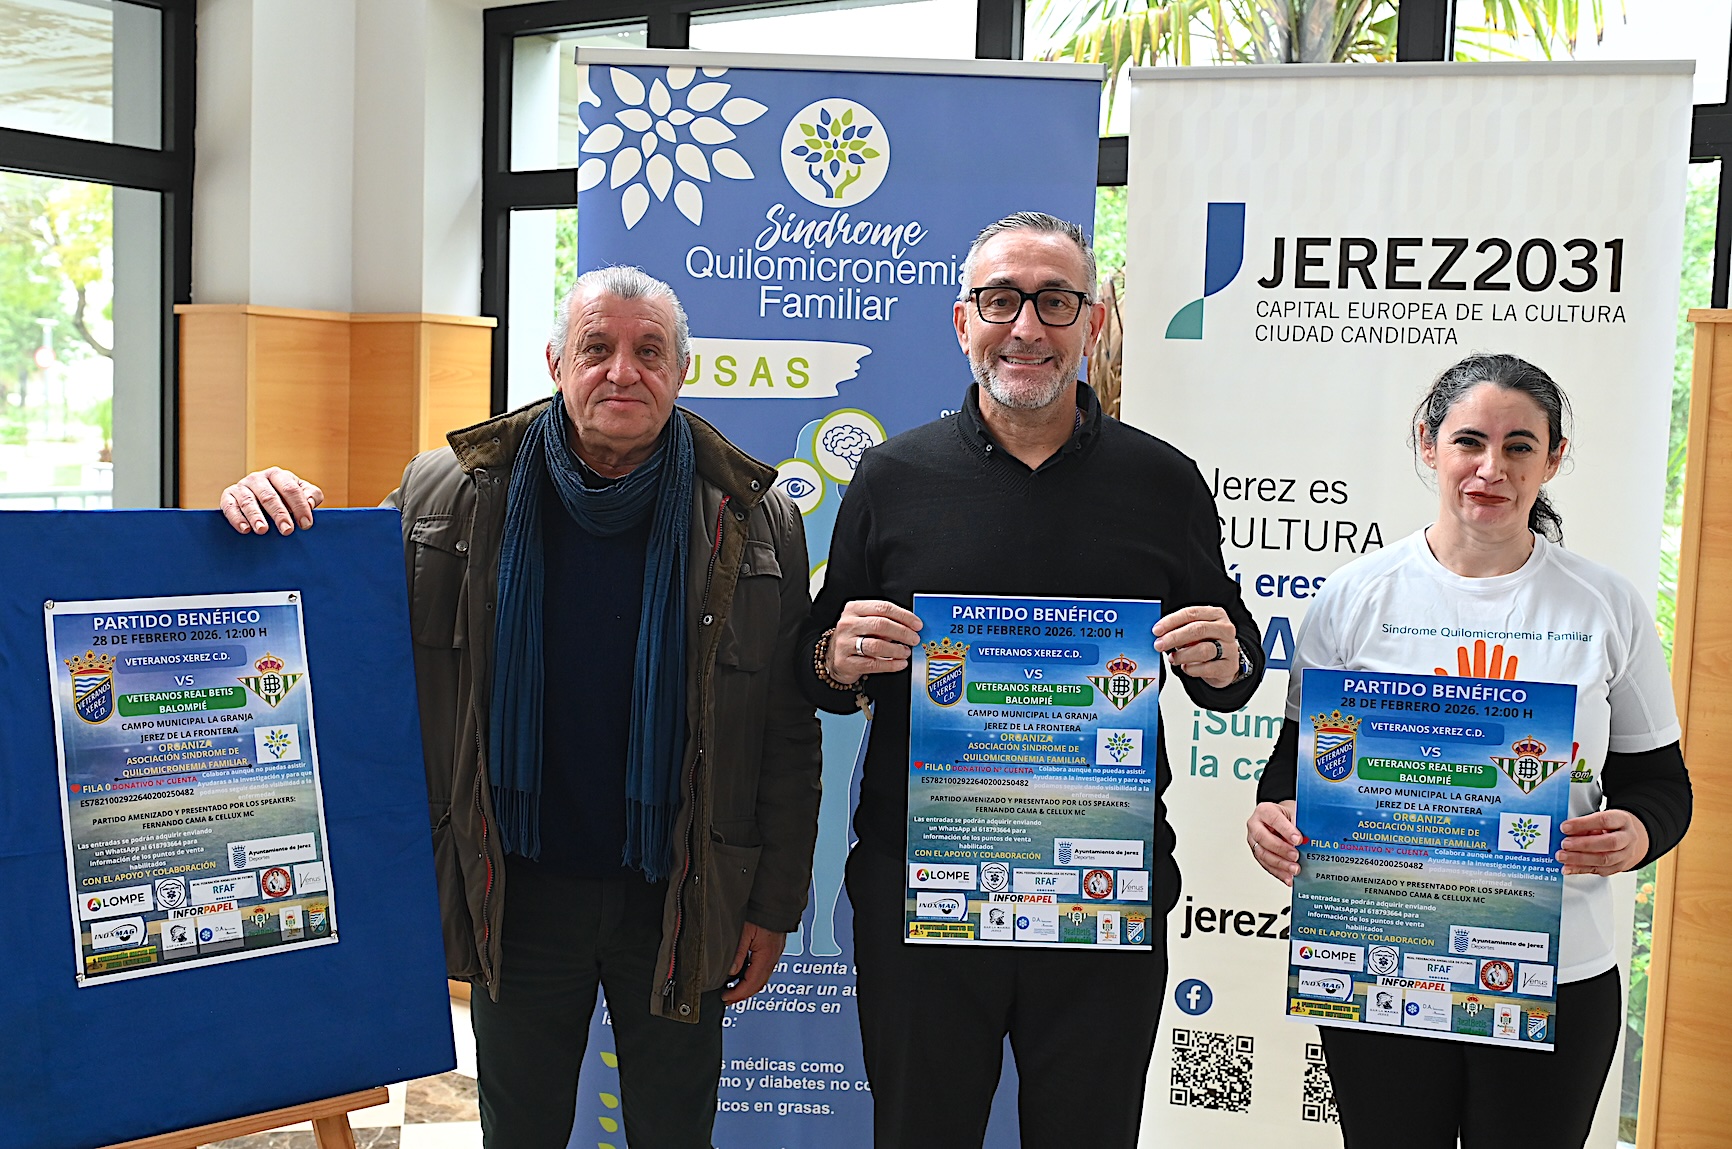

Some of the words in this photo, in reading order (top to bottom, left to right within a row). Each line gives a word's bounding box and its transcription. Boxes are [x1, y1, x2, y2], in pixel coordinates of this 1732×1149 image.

[1257, 237, 1625, 293] JEREZ2031
[759, 285, 899, 321] Familiar
[1256, 300, 1340, 319] CAPITAL
[1347, 302, 1448, 321] EUROPEA
[1456, 303, 1484, 321] DE
[1492, 303, 1518, 322] LA
[1524, 304, 1627, 324] CULTURA
[1255, 324, 1334, 343] CIUDAD
[1341, 325, 1459, 345] CANDIDATA
[684, 354, 810, 389] USAS
[1211, 467, 1296, 503] Jerez
[1309, 479, 1349, 504] es
[93, 614, 172, 631] PARTIDO
[177, 607, 260, 627] BENÉFICO
[952, 605, 1028, 620] PARTIDO
[1034, 605, 1117, 623] BENÉFICO
[92, 636, 107, 647] 28
[112, 634, 127, 646] DE
[131, 631, 186, 645] FEBRERO
[190, 629, 221, 641] 2026.
[225, 627, 255, 639] 12:00
[259, 626, 267, 637] H
[950, 623, 964, 633] 28
[968, 623, 982, 634] DE
[987, 624, 1040, 636] FEBRERO
[1045, 626, 1075, 637] 2026.
[1080, 627, 1111, 638] 12:00
[1115, 628, 1123, 638] H
[1441, 627, 1542, 641] Quilomicronemia
[1547, 631, 1593, 642] Familiar
[124, 655, 180, 666] VETERANOS
[181, 653, 210, 662] XEREZ
[212, 652, 230, 660] C.D.
[978, 647, 1032, 656] VETERANOS
[1034, 649, 1062, 657] XEREZ
[174, 674, 194, 685] VS
[1024, 668, 1043, 678] VS
[125, 691, 182, 703] VETERANOS
[183, 689, 207, 698] REAL
[209, 687, 233, 696] BETIS
[975, 683, 1029, 692] VETERANOS
[1031, 684, 1054, 692] REAL
[1056, 685, 1080, 693] BETIS
[1343, 678, 1427, 696] PARTIDO
[1433, 680, 1527, 702] BENÉFICO
[158, 700, 207, 713] BALOMPIÉ
[1005, 694, 1052, 704] BALOMPIÉ
[1341, 696, 1356, 707] 28
[1360, 697, 1376, 709] DE
[1381, 698, 1440, 713] FEBRERO
[1445, 702, 1479, 715] 2026.
[1484, 705, 1519, 718] 12:00
[1523, 707, 1533, 719] H
[120, 721, 154, 731] CAMPO
[156, 717, 204, 727] MUNICIPAL
[207, 715, 218, 723] LA
[220, 712, 253, 723] GRANJA
[1193, 706, 1285, 740] ¡Súm
[1371, 722, 1430, 734] VETERANOS
[1432, 726, 1464, 736] XEREZ
[1466, 729, 1485, 737] C.D.
[1317, 740, 1353, 768] VETERANOS
[1420, 746, 1441, 757] VS
[1190, 746, 1218, 778] la
[1233, 757, 1269, 781] ca
[1324, 756, 1347, 773] XEREZ
[1367, 759, 1426, 771] VETERANOS
[1428, 763, 1454, 773] REAL
[1456, 765, 1483, 775] BETIS
[1399, 772, 1451, 785] BALOMPIÉ
[1357, 786, 1392, 795] CAMPO
[1394, 789, 1445, 799] MUNICIPAL
[1464, 794, 1501, 805] GRANJA
[1375, 800, 1401, 810] JEREZ
[1403, 802, 1415, 810] DE
[1418, 803, 1430, 811] LA
[1432, 804, 1482, 815] FRONTERA
[1358, 818, 1414, 831] ASOCIACIÓN
[1416, 825, 1465, 835] SINDROME
[1392, 812, 1450, 825] ORGANIZA
[1311, 839, 1330, 848] FILA
[1340, 843, 1382, 853] DONATIVO
[1397, 848, 1428, 856] CUENTA
[1352, 831, 1440, 846] QUILOMICRONEMIA
[1443, 839, 1487, 849] FAMILIAR
[1315, 872, 1349, 882] PARTIDO
[1350, 875, 1397, 886] AMENIZADO
[1406, 880, 1457, 891] PRESENTADO
[1477, 886, 1492, 894] LOS
[1493, 887, 1534, 897] SPEAKERS:
[1364, 887, 1406, 896] FERNANDO
[1409, 890, 1432, 898] CAMA
[1441, 893, 1470, 902] CELLUX
[172, 902, 233, 918] INFORPAPEL
[1180, 895, 1291, 940] jerez2
[1298, 926, 1316, 935] CON
[1319, 928, 1328, 936] EL
[1329, 929, 1358, 939] APOYO
[1360, 932, 1366, 940] Y
[1368, 932, 1434, 946] COLABORACIÓN
[793, 961, 848, 975] cuenta
[1427, 963, 1451, 973] RFAF
[759, 983, 813, 996] ovocar
[816, 985, 838, 996] un
[841, 985, 858, 997] au
[1381, 977, 1445, 991] INFORPAPEL
[726, 997, 817, 1014] iglicéridos
[820, 1002, 841, 1014] en
[730, 1057, 796, 1072] médicas
[800, 1061, 845, 1074] como
[718, 1077, 741, 1088] mo
[745, 1077, 756, 1091] y
[759, 1074, 826, 1091] diabetes
[830, 1080, 850, 1091] no
[854, 1081, 872, 1092] co
[717, 1098, 750, 1112] icos
[753, 1101, 774, 1112] en
[777, 1101, 835, 1116] grasas.
